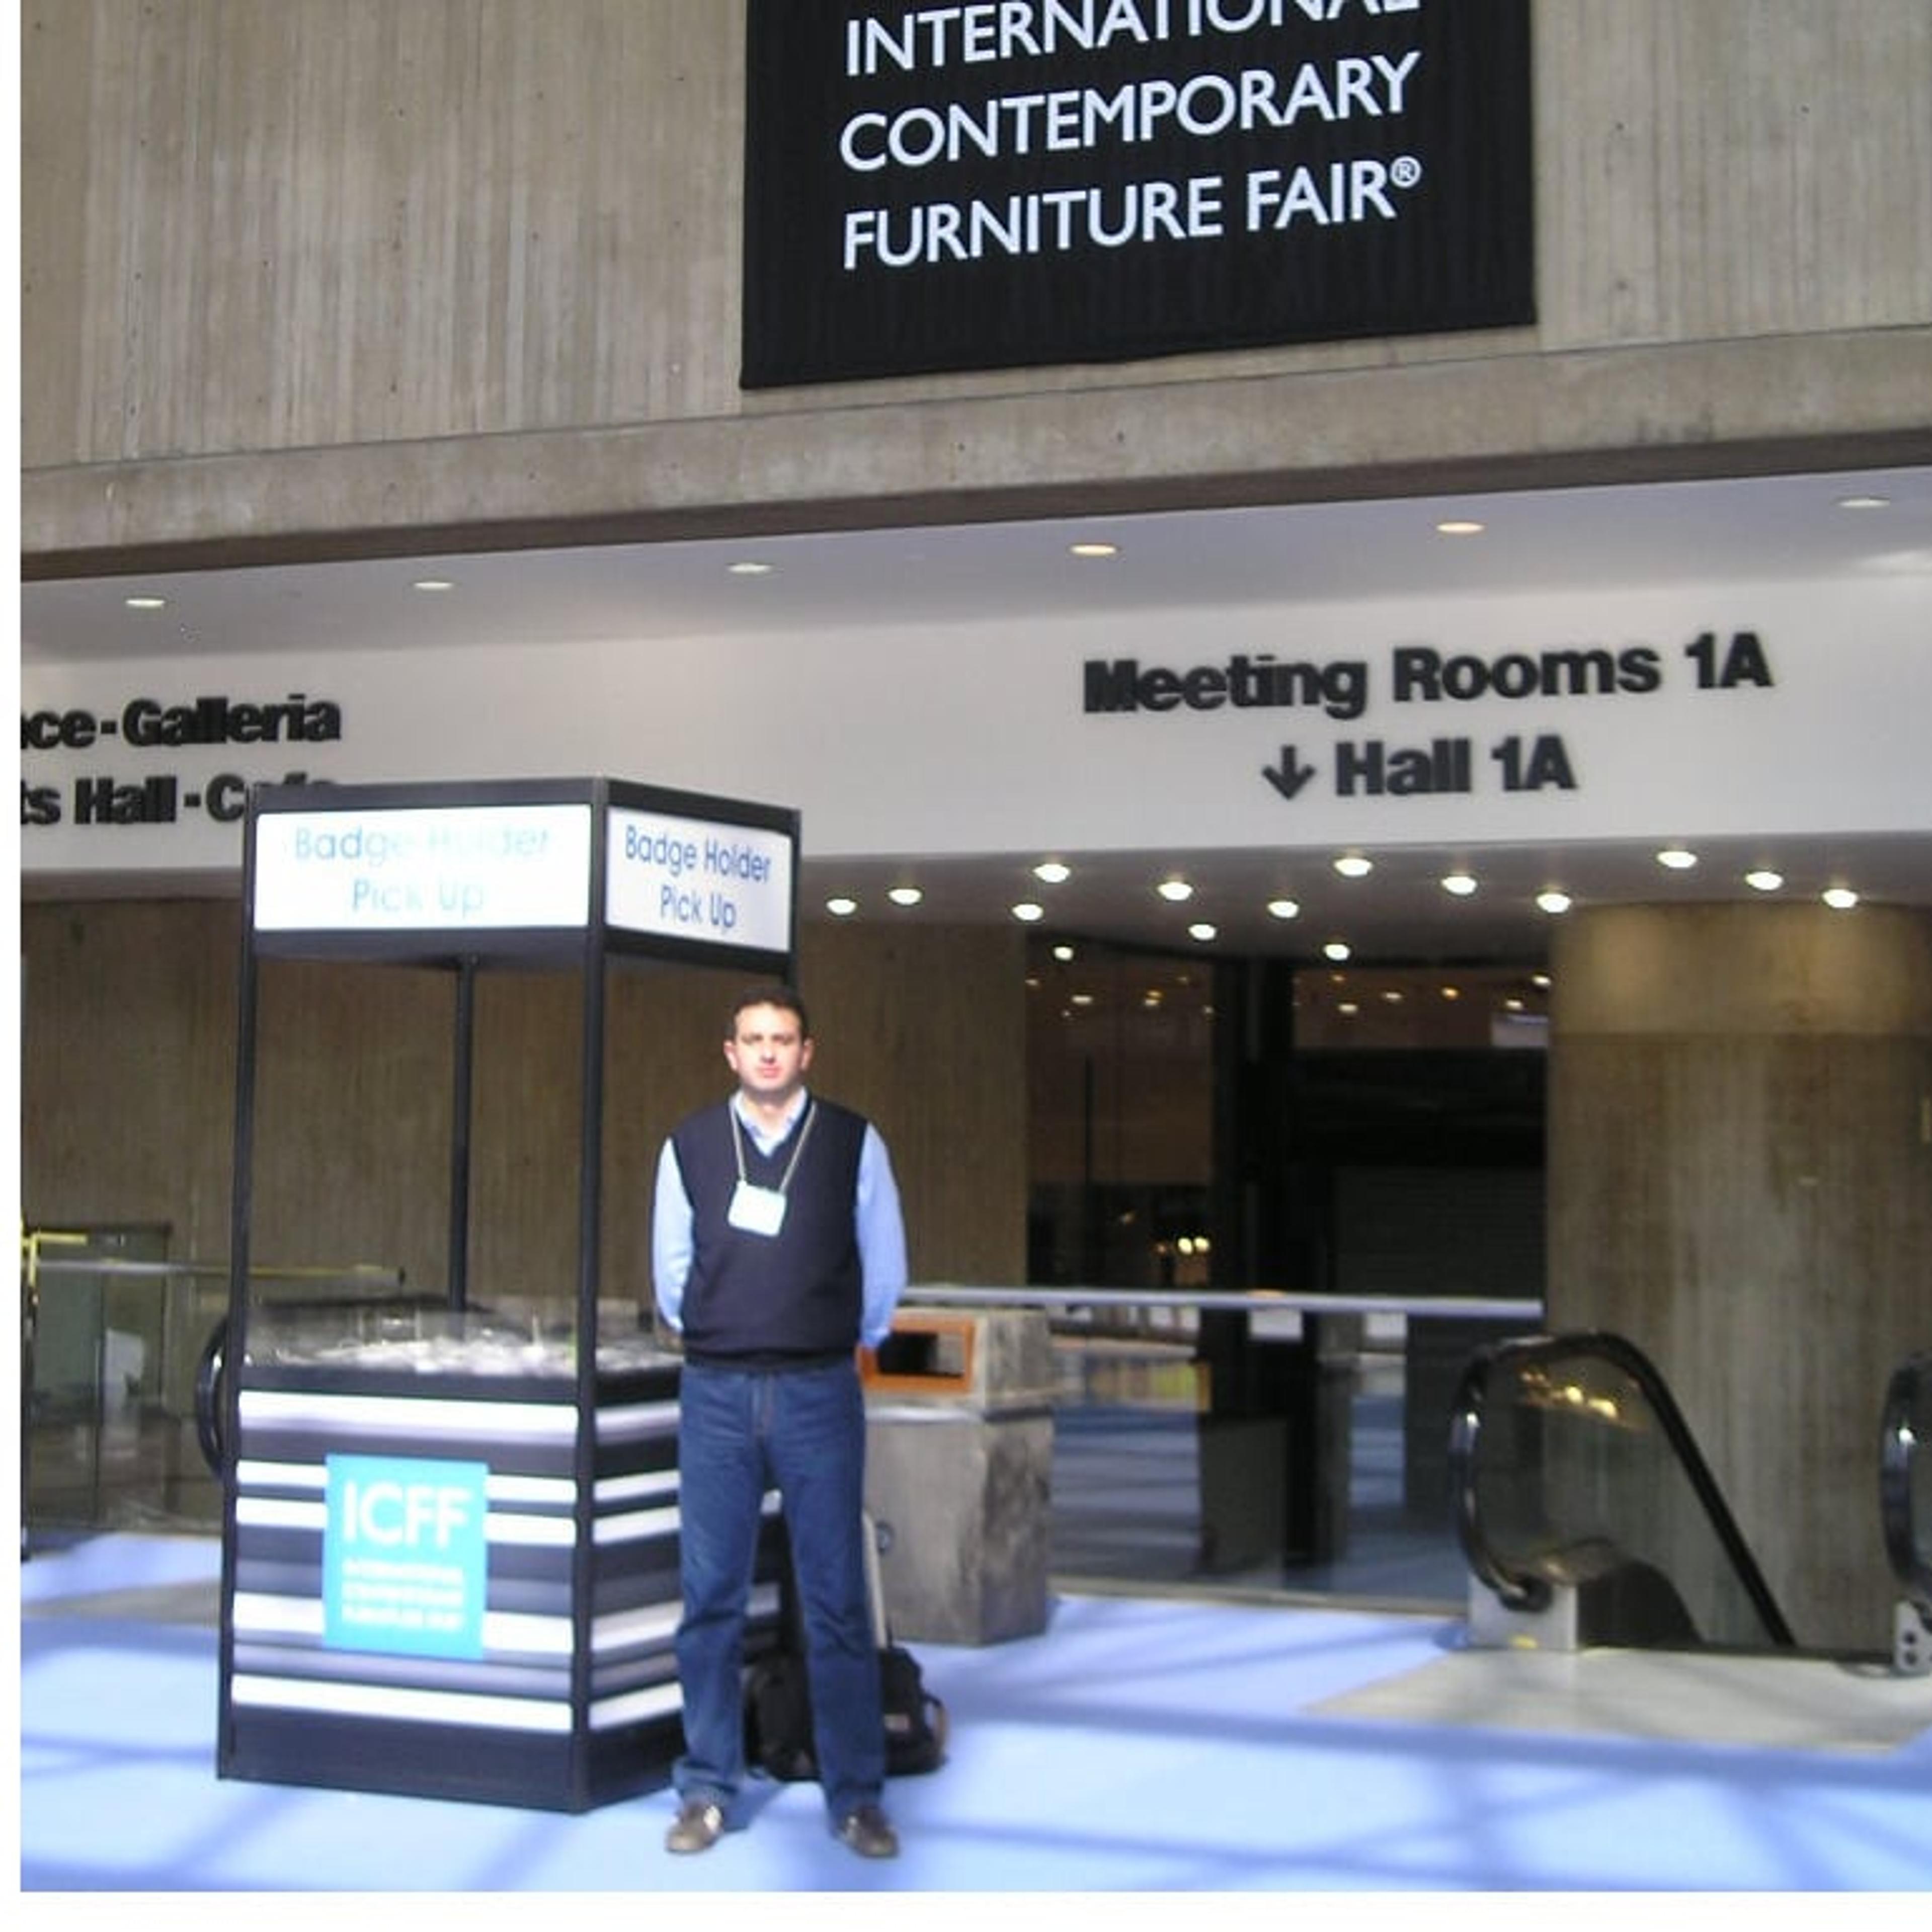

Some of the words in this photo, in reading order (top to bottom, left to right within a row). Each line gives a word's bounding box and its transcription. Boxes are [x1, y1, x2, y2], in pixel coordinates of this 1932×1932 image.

[848, 0, 1419, 75] INTERNATIO
[840, 51, 1420, 171] CONTEMPORARY
[844, 176, 1222, 269] FURNITURE
[1083, 655, 1368, 720] Meeting
[1393, 647, 1661, 702] Rooms
[1685, 632, 1774, 689] 1A
[1335, 738, 1471, 796] Hall
[1491, 735, 1577, 792] 1A
[427, 825, 552, 857] Hder
[626, 825, 697, 876] Badge
[705, 839, 770, 882] Holder
[660, 884, 702, 924] Pick
[710, 893, 737, 934] Up
[343, 1480, 472, 1550] ICFF
